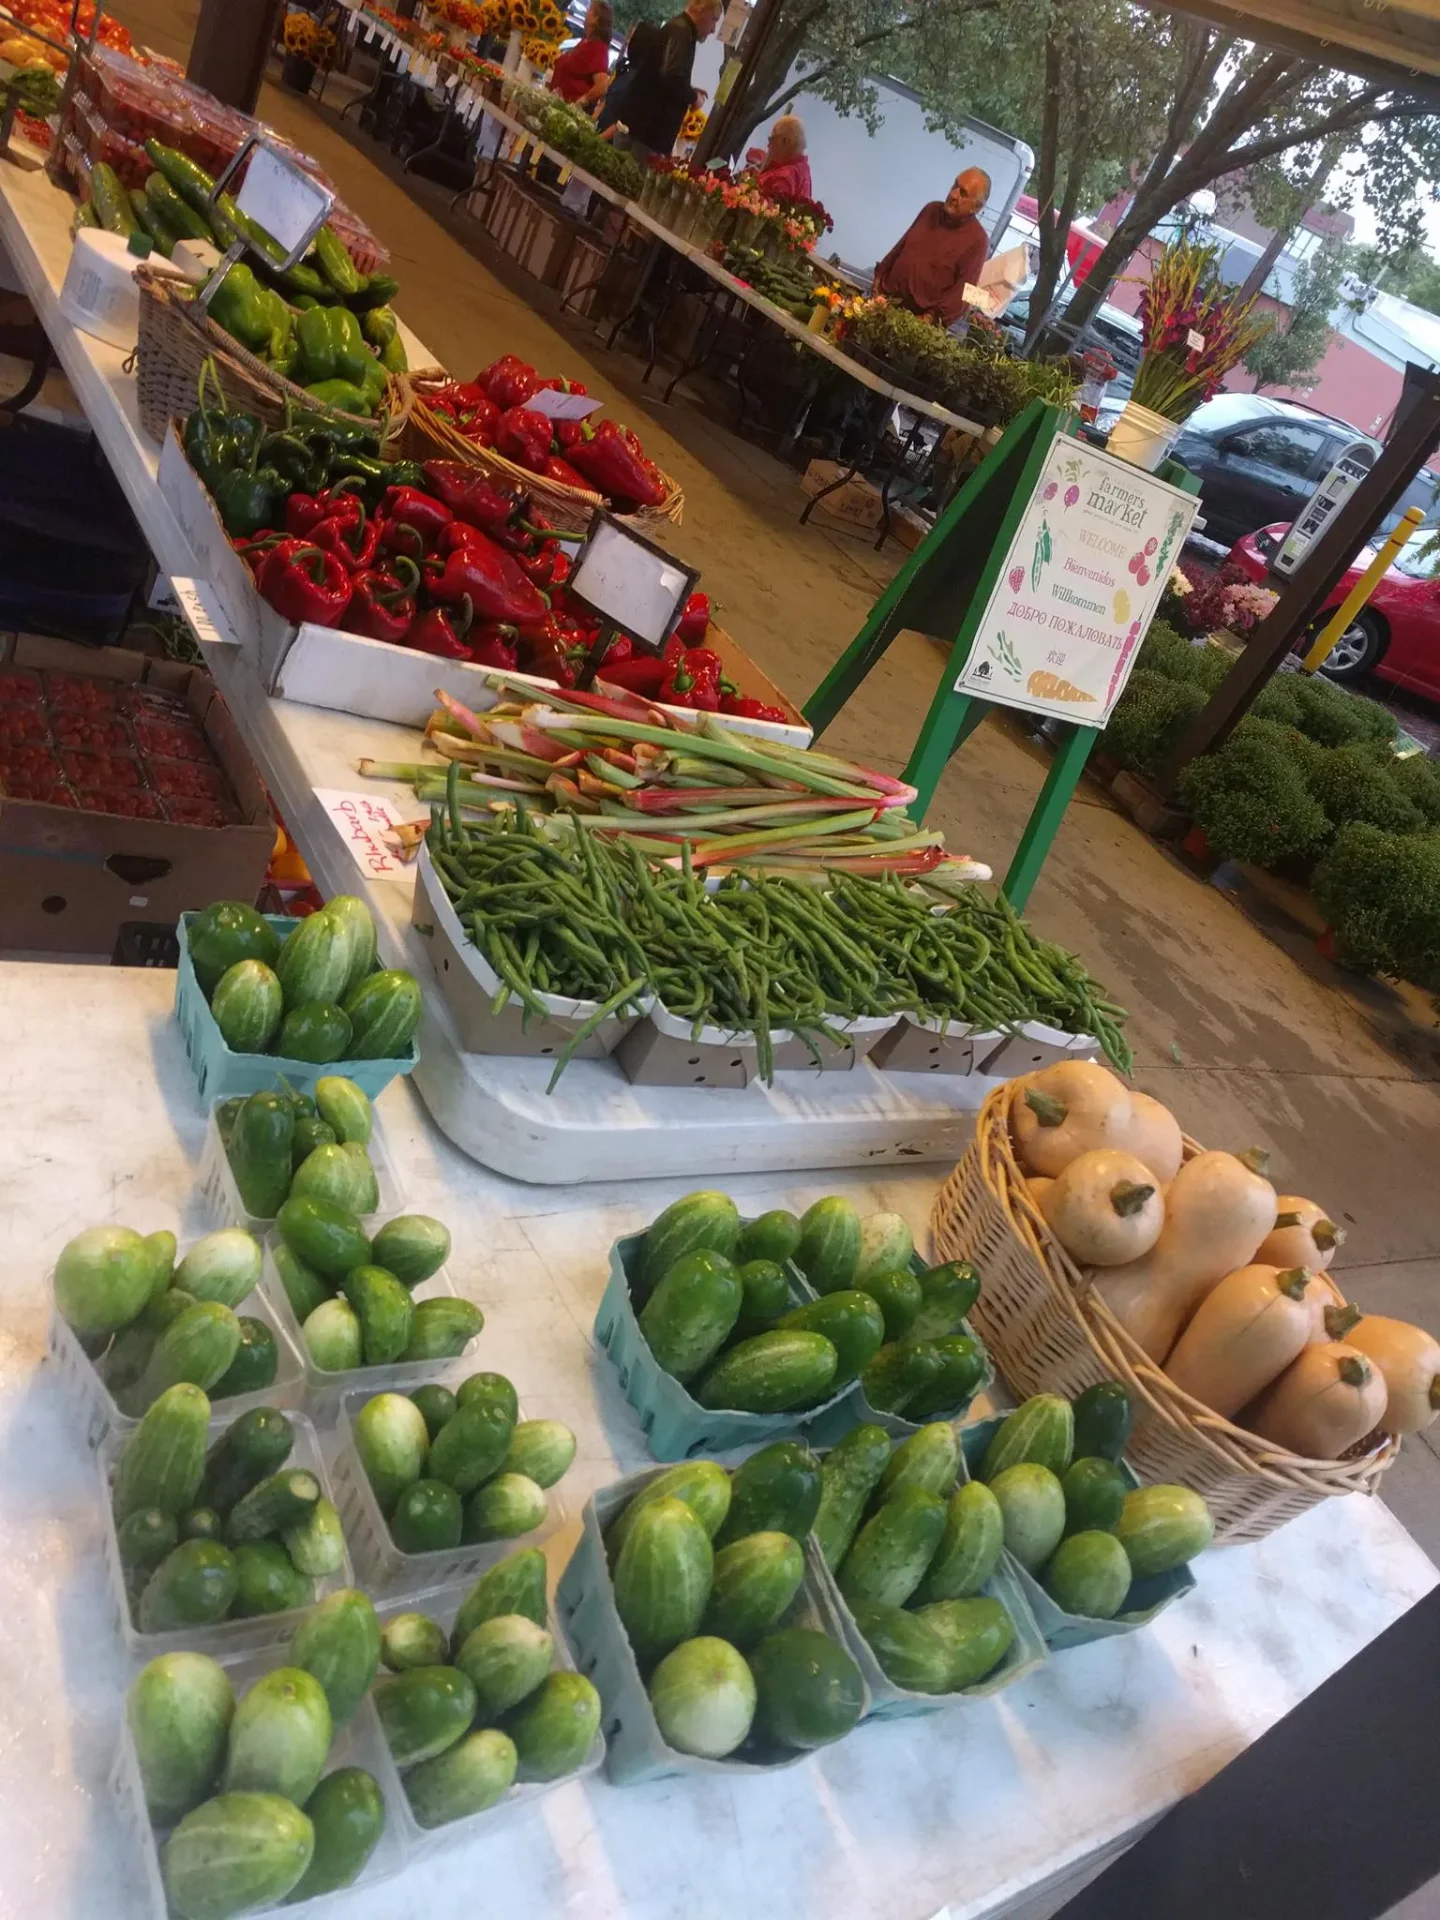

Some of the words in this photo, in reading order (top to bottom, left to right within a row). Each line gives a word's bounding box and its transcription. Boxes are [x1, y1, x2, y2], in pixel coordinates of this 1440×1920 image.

[1099, 476, 1145, 509] farmers
[1087, 491, 1148, 529] market
[1080, 529, 1127, 559] WELCOME
[1063, 557, 1116, 588] Bienvenidos
[1051, 584, 1106, 615] Willkommen
[1007, 602, 1048, 624] ДОБРО
[1048, 615, 1123, 650] ПОЖАЛОВАТЬ
[1045, 649, 1067, 667] 欢迎
[332, 800, 393, 873] Rhubarb
